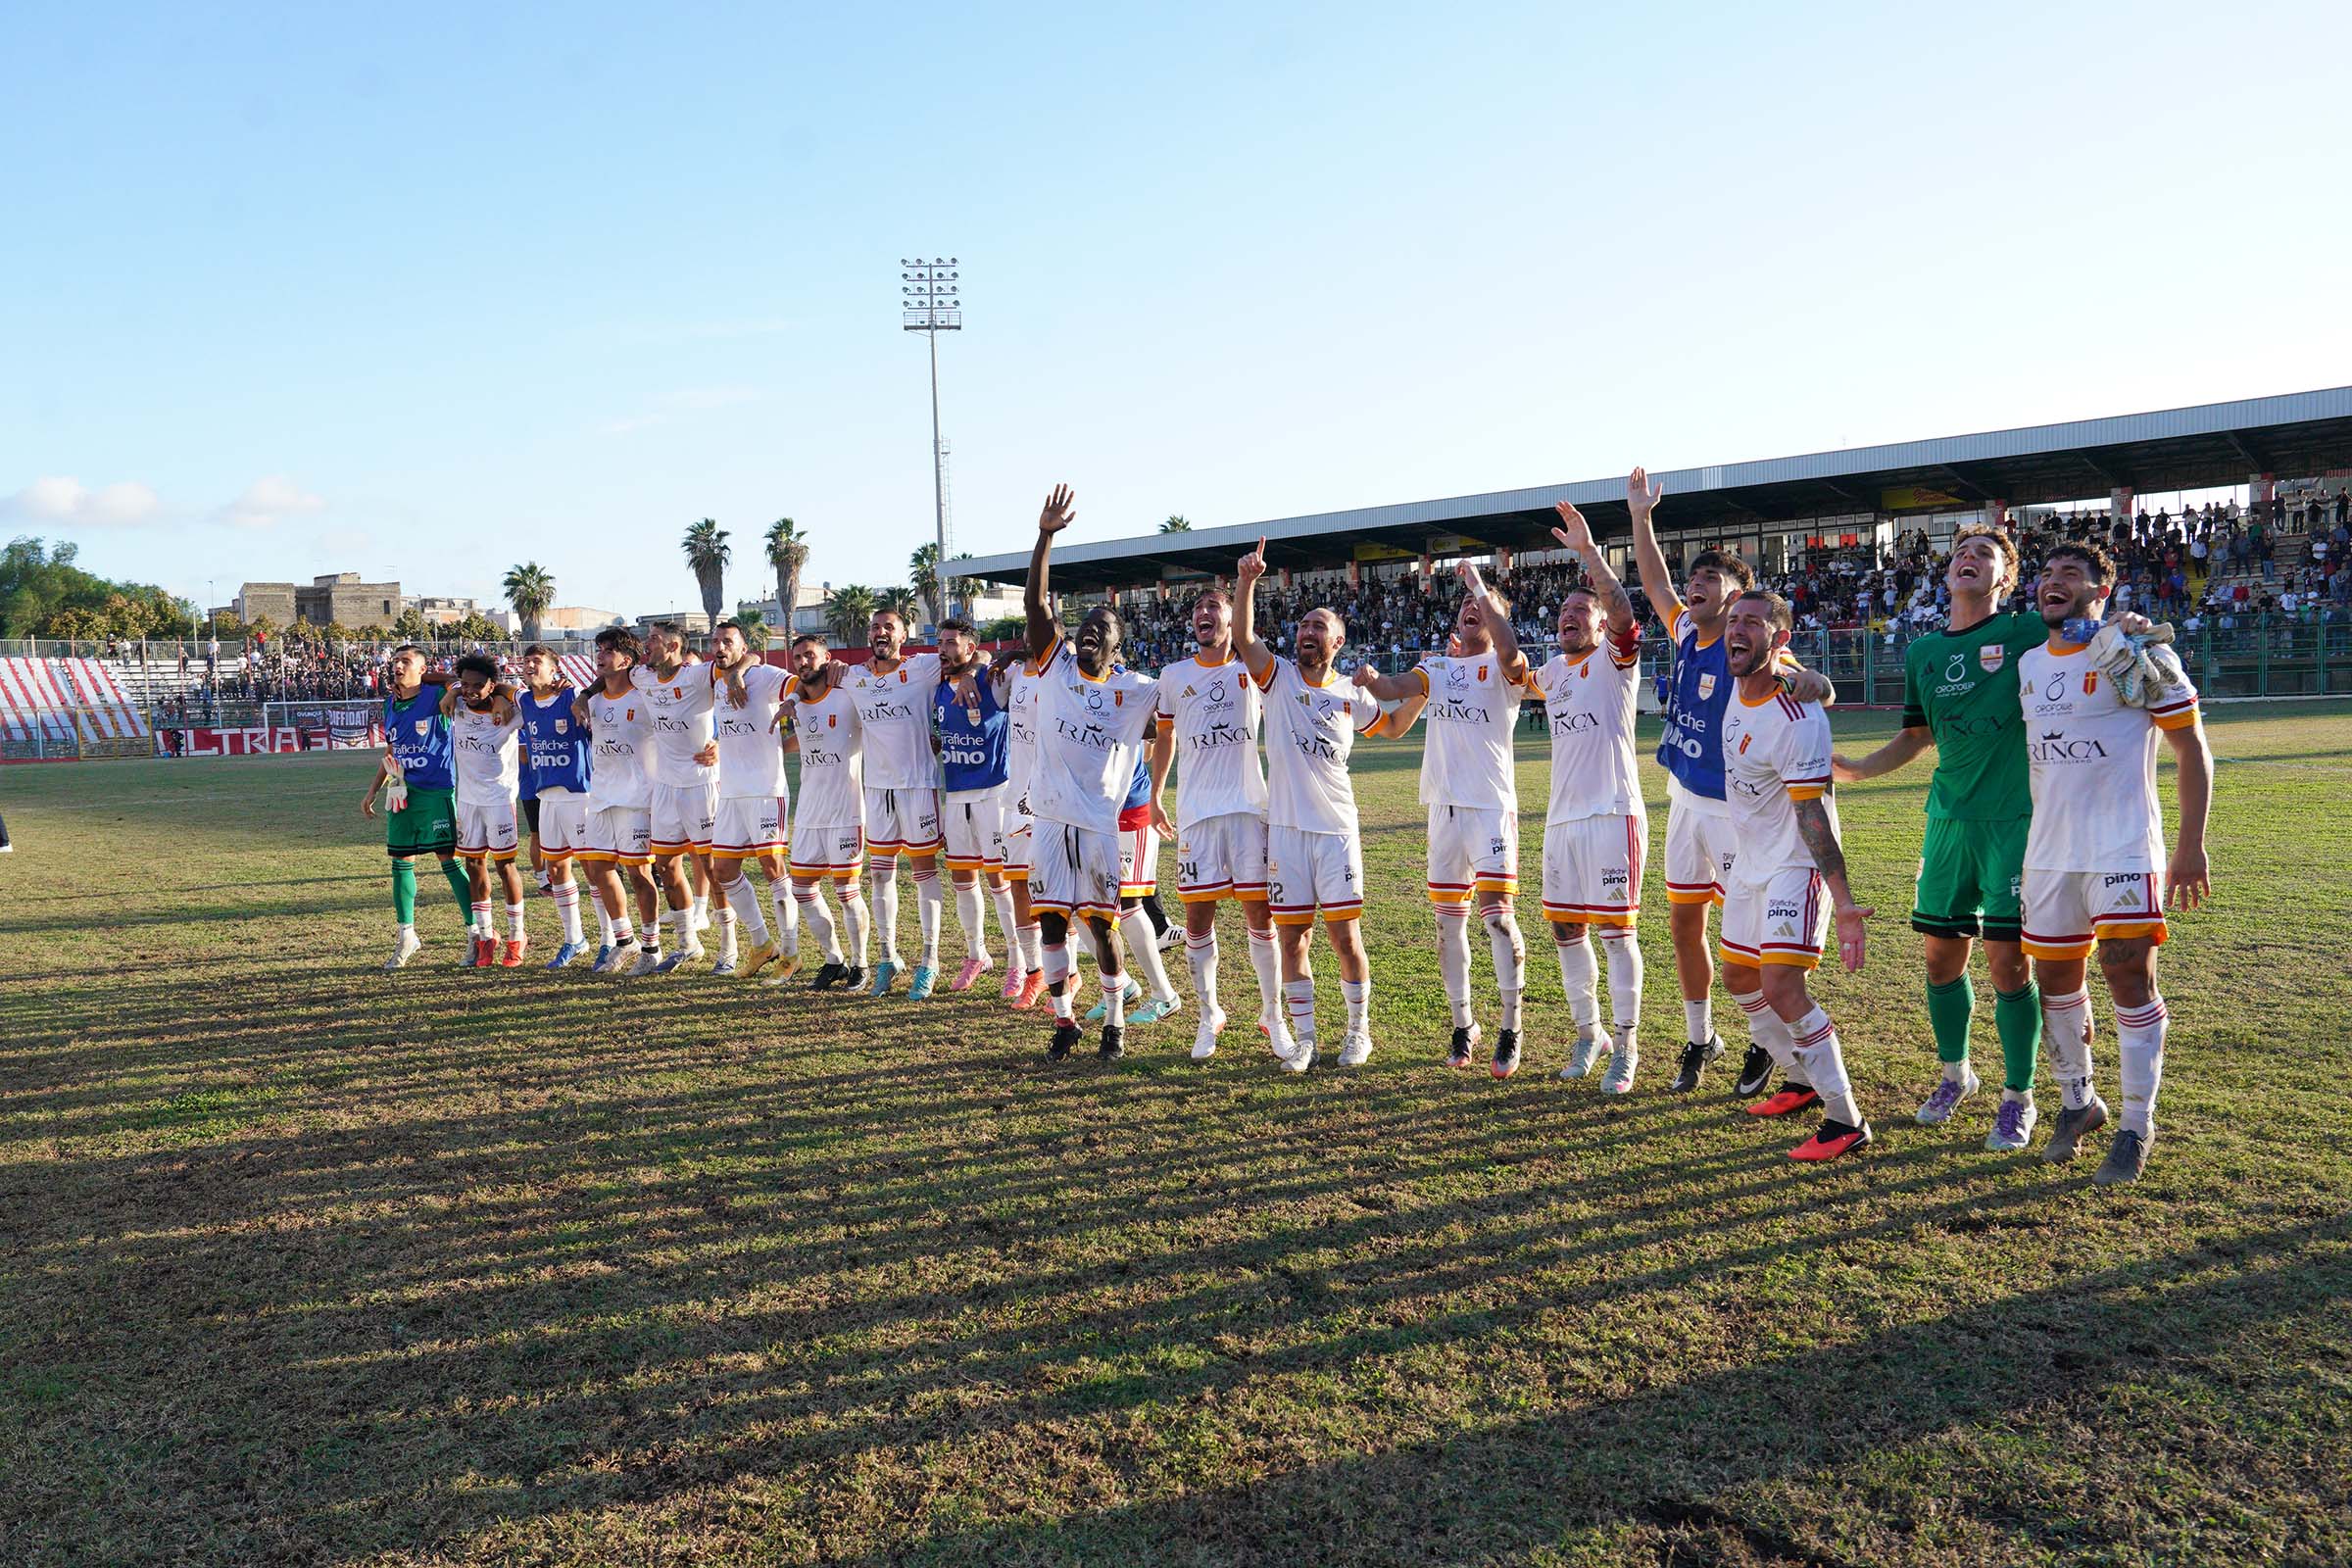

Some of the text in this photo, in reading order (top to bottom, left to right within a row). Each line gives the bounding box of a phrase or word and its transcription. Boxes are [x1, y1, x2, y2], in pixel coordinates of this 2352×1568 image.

[328, 709, 369, 726] DIFFIDATI
[938, 706, 945, 722] 8
[1429, 702, 1491, 723] TRINCA
[527, 721, 538, 735] 16
[1552, 711, 1599, 736] INCA
[393, 744, 429, 755] rafiche
[531, 740, 569, 752] grafiche
[2028, 739, 2110, 761] RINCA
[397, 755, 429, 768] ino
[531, 751, 570, 770] pino
[701, 821, 714, 831] pin
[839, 842, 858, 851] pino
[1178, 861, 1199, 883] 24
[1602, 875, 1628, 887] pino
[2104, 872, 2141, 888] pino
[1767, 906, 1798, 919] pino
